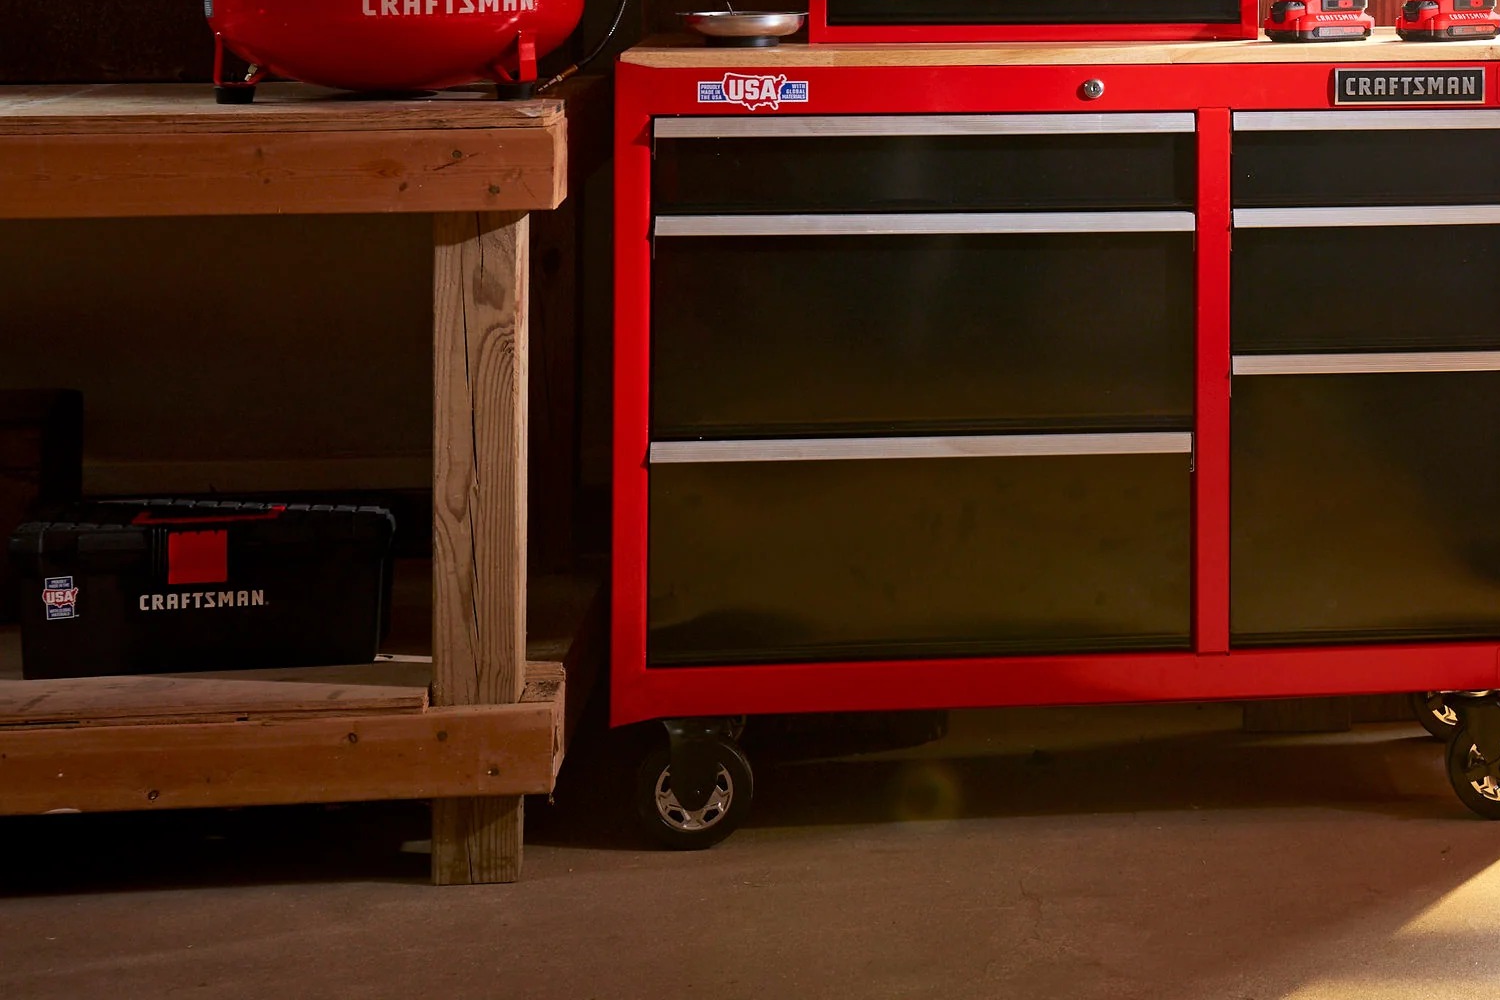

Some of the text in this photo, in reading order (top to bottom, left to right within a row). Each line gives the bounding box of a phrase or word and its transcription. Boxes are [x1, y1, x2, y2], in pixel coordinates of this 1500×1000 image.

[728, 79, 778, 100] USA
[1345, 76, 1476, 96] CRAFTSMAN
[45, 590, 73, 603] USA
[139, 589, 264, 611] CRAFTSMAN
